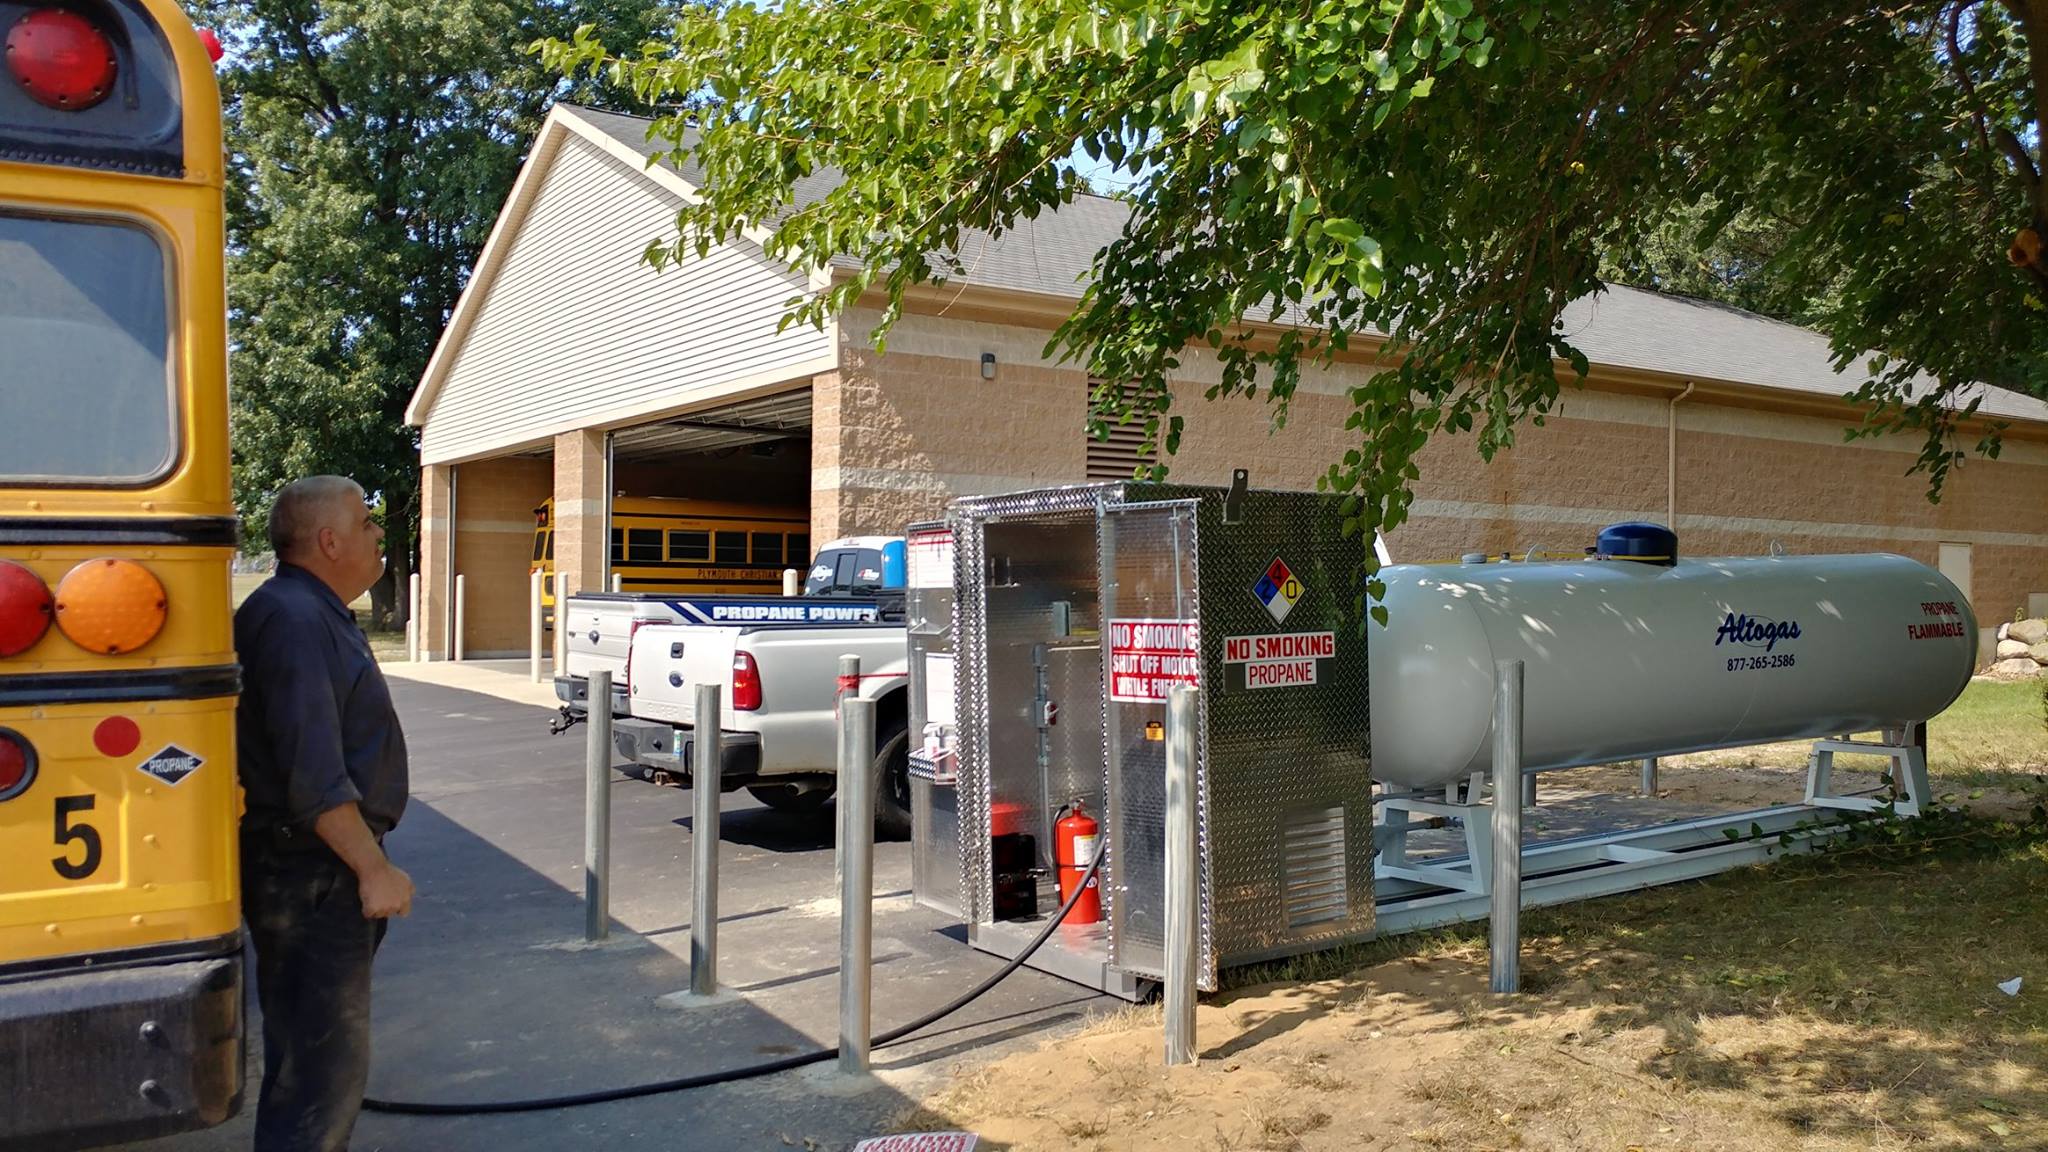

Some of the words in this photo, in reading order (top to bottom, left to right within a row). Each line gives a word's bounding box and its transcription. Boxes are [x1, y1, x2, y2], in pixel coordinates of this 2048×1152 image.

[1272, 564, 1283, 580] 4
[1261, 580, 1271, 599] 2
[1286, 580, 1297, 599] 0
[713, 606, 805, 620] PROPANE
[1921, 601, 1959, 616] PROPANE
[1113, 624, 1131, 648] NO
[1134, 625, 1197, 649] SMOKING
[1715, 613, 1801, 652] Altogas
[1908, 622, 1964, 640] FLAMMABLE
[1227, 639, 1250, 660] NO
[1256, 635, 1333, 658] SMOKING
[1113, 655, 1139, 673] SHUT
[1140, 655, 1160, 674] OFF
[1727, 654, 1796, 672] 877-265-2586
[1249, 662, 1313, 686] PROPANE
[1117, 677, 1148, 696] WHILE
[149, 757, 195, 774] PROPANE
[51, 794, 102, 880] 5
